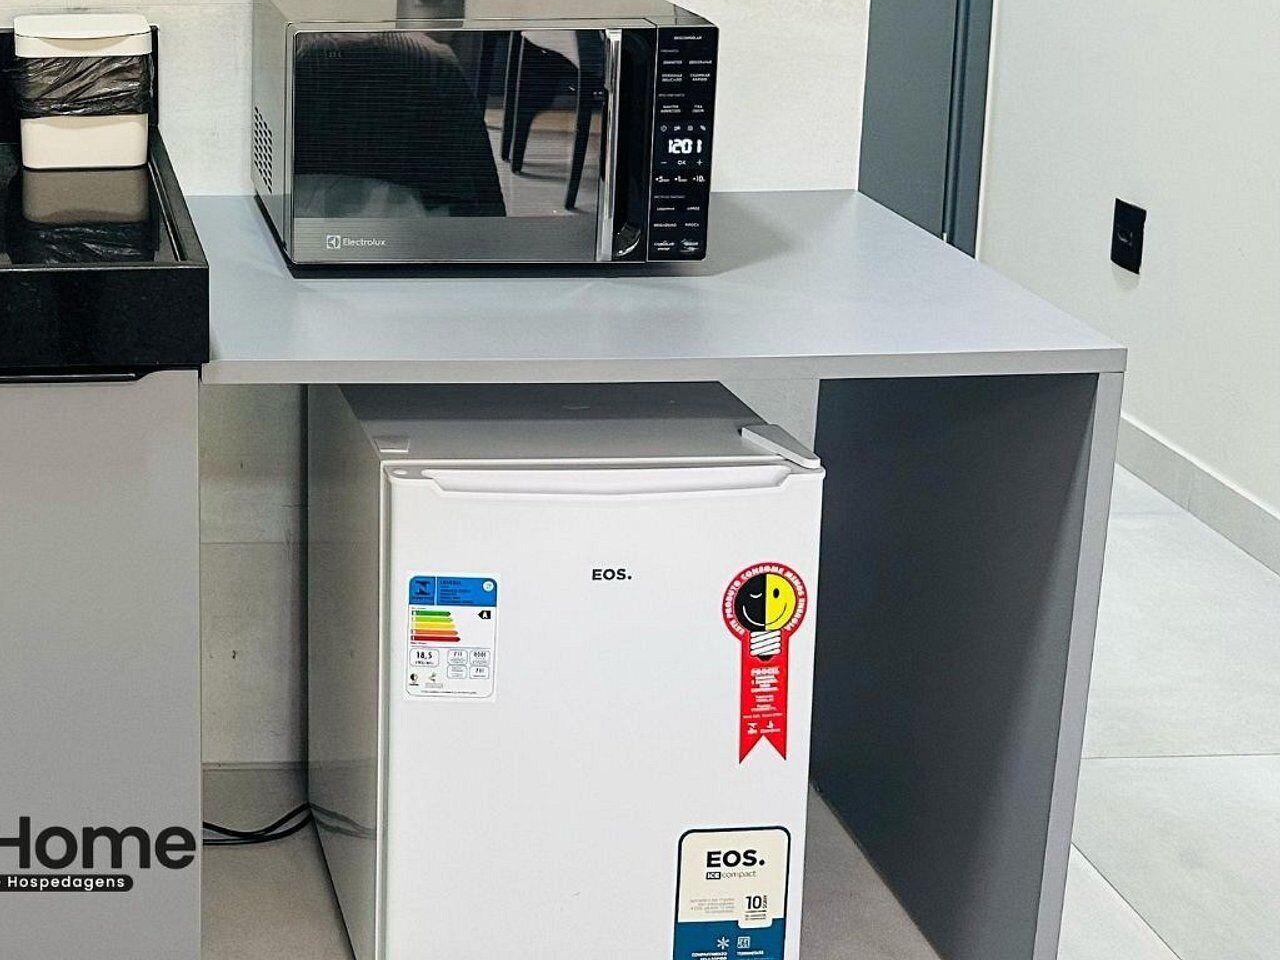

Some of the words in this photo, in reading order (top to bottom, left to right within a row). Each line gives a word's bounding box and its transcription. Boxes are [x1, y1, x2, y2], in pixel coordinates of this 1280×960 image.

[342, 237, 387, 246] Electrolux
[592, 568, 632, 580] EOS.
[706, 849, 766, 868] EOS.
[745, 895, 762, 910] 10
